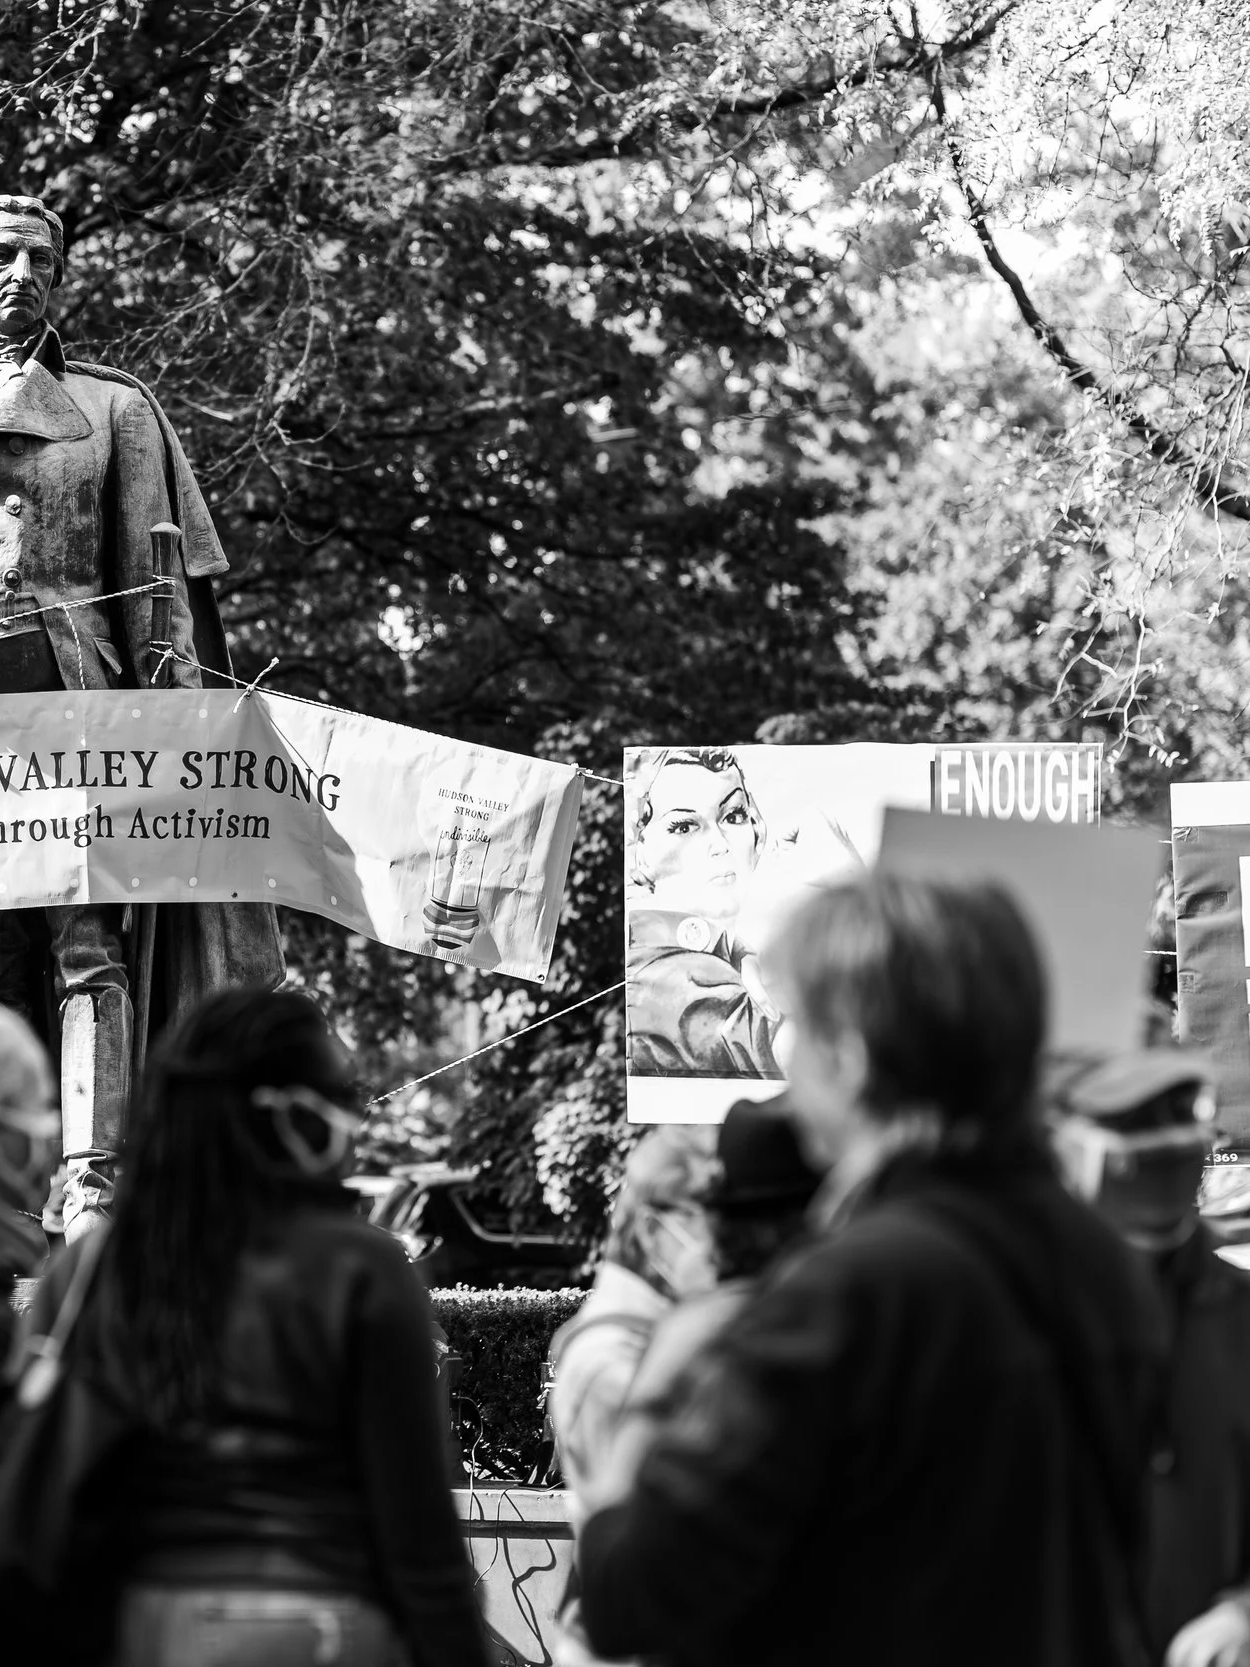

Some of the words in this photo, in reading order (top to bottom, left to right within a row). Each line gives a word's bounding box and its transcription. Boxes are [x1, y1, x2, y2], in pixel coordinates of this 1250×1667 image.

[180, 750, 341, 812] STRONG
[941, 751, 1095, 824] ENOUGH
[438, 788, 474, 804] HUDSON
[478, 797, 509, 812] VALLEY
[454, 805, 489, 821] STRONG
[127, 807, 271, 840] Activism
